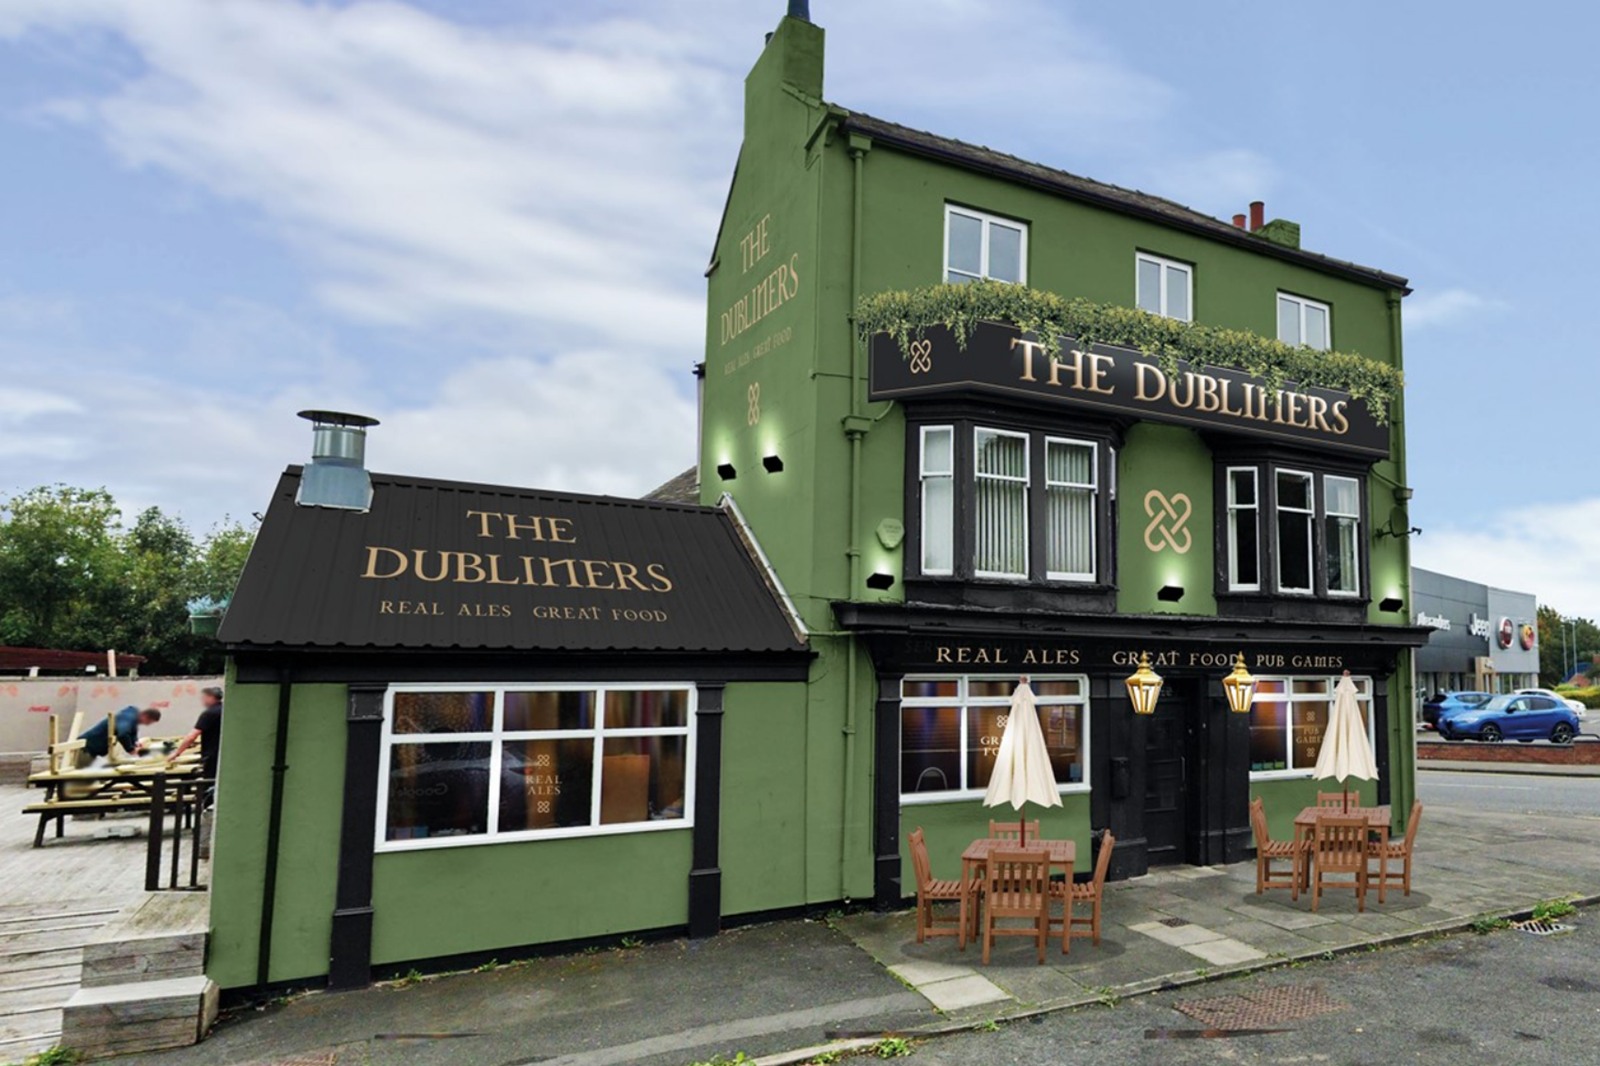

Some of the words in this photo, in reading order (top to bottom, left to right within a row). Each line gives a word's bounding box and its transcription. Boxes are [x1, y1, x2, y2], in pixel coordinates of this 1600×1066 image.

[740, 214, 770, 274] THE
[721, 253, 798, 346] DUBLINERS
[1009, 336, 1116, 395] THE
[1132, 361, 1350, 435] DUBLINERS
[466, 509, 577, 543] THE
[360, 546, 674, 593] DUBLINERS
[379, 600, 445, 616] REAL
[457, 603, 512, 618] ALES
[532, 605, 602, 621] GREAT
[612, 608, 668, 623] FOOD
[1470, 613, 1490, 641] Jeep
[936, 647, 1009, 664] REAL
[1022, 649, 1080, 665] ALES
[1189, 652, 1240, 667] FOOD
[1256, 654, 1286, 667] PUB
[1291, 655, 1343, 668] GAMES
[1295, 735, 1324, 744] GAME
[525, 774, 563, 785] REAL
[527, 785, 562, 796] ALES
